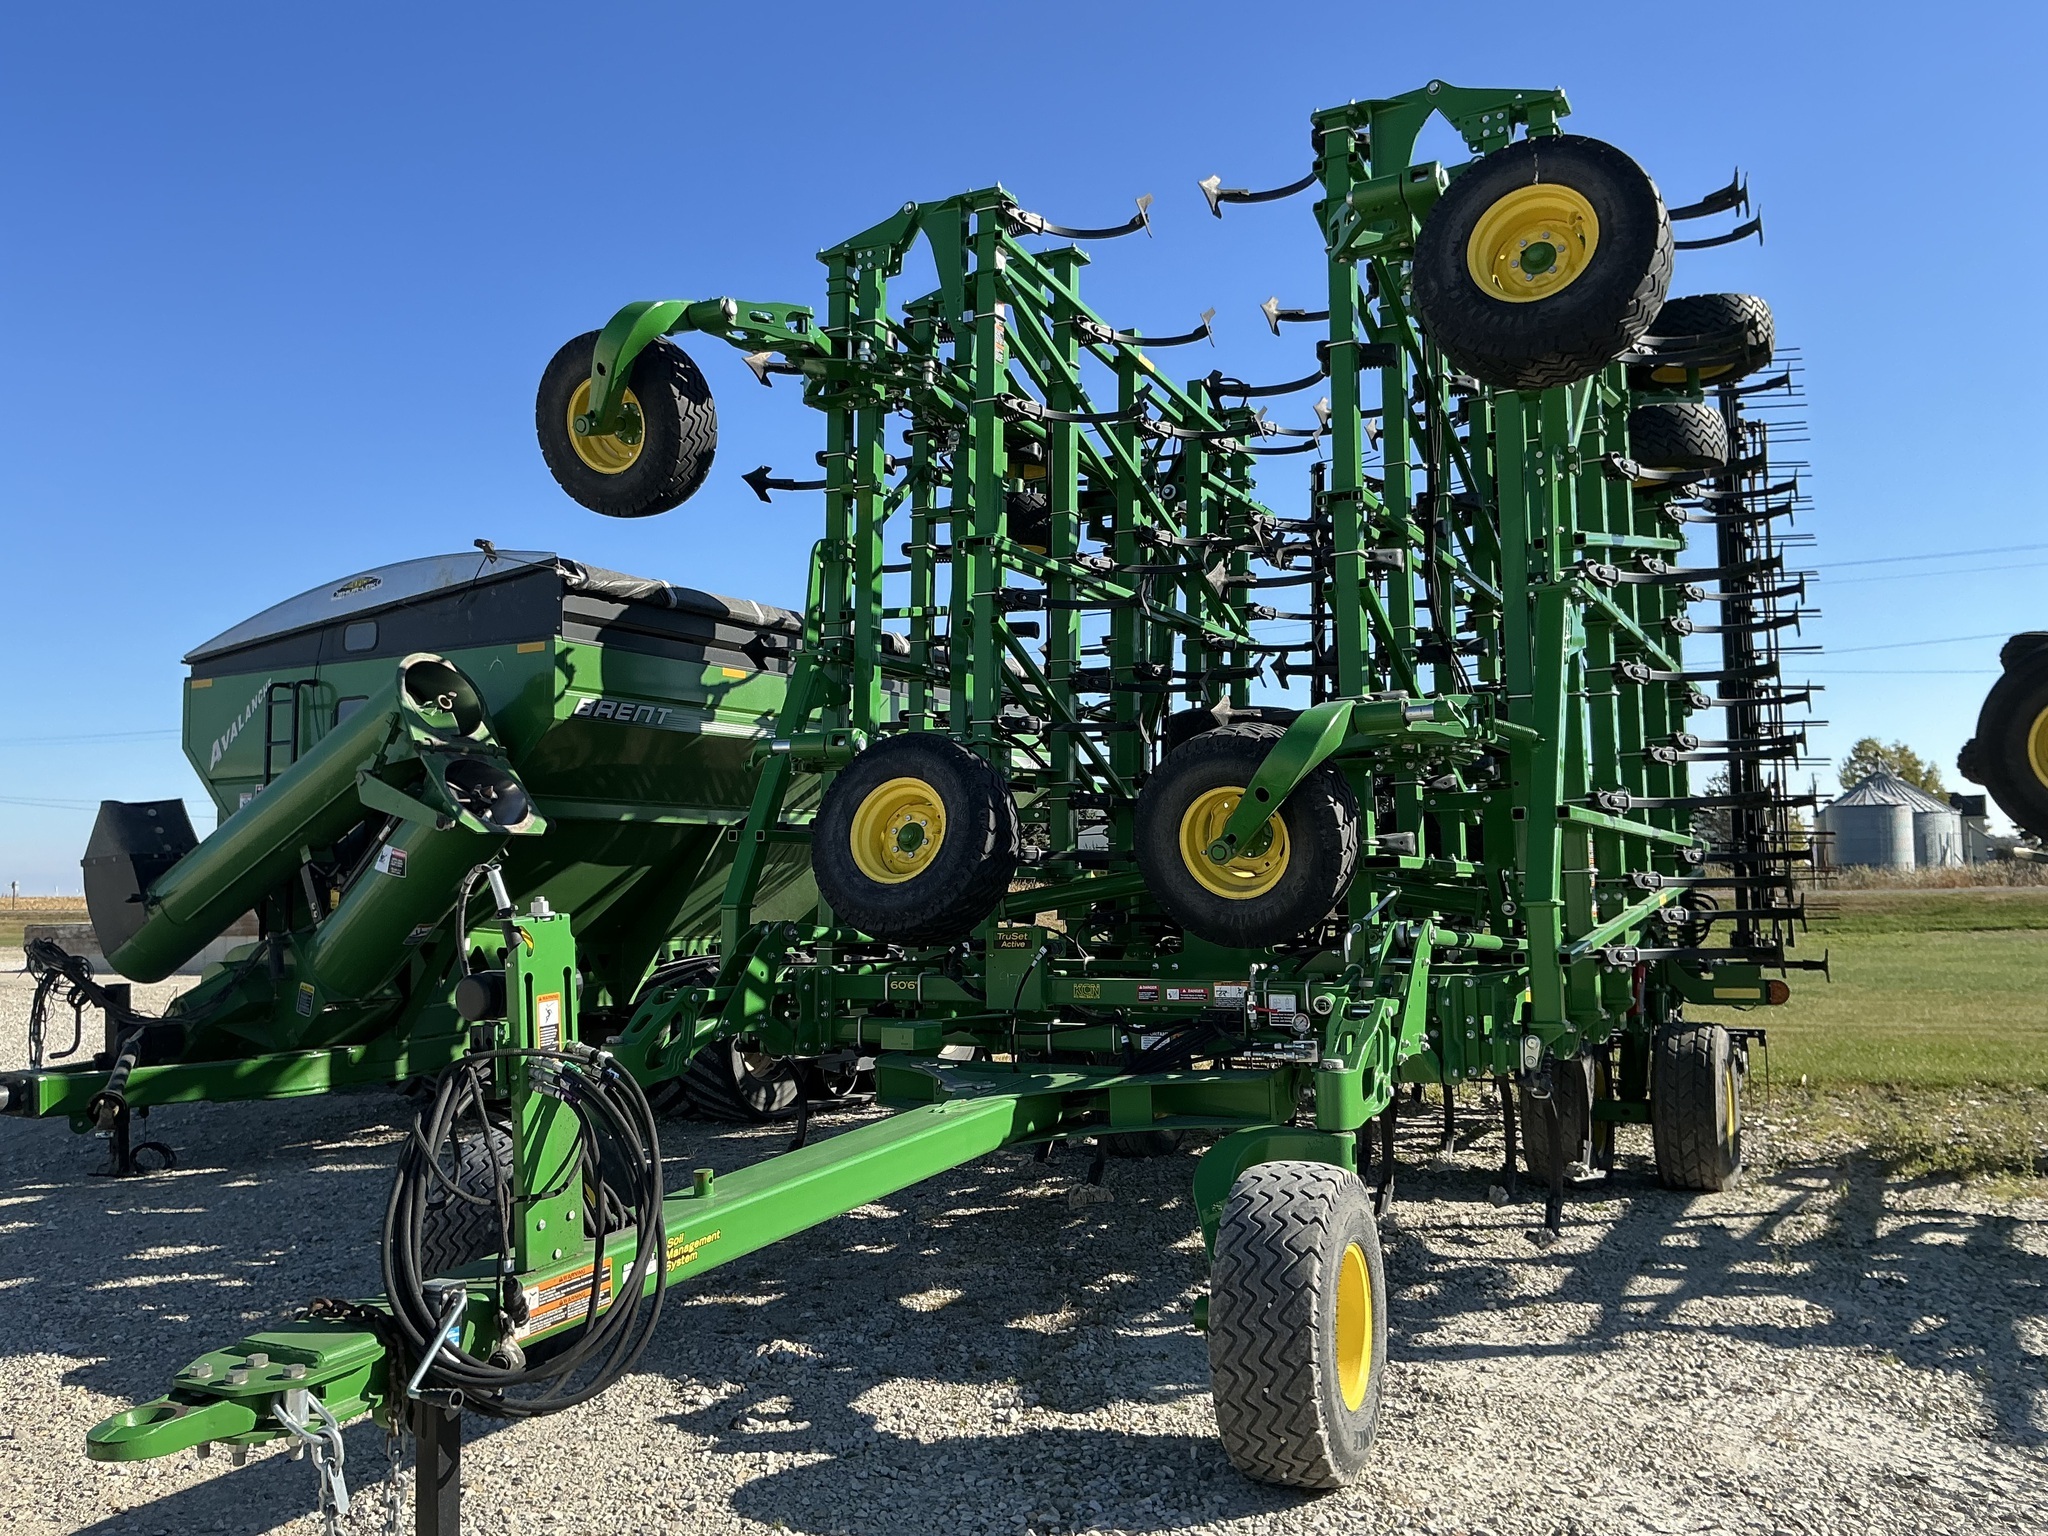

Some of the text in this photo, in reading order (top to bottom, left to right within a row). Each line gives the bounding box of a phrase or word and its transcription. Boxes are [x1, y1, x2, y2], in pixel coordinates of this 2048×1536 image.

[574, 698, 673, 725] BRENT
[209, 678, 272, 772] AVALANCHE
[997, 932, 1028, 940] TruSet
[666, 1229, 721, 1260] Management
[667, 1232, 685, 1249] Soil
[666, 1251, 698, 1272] System
